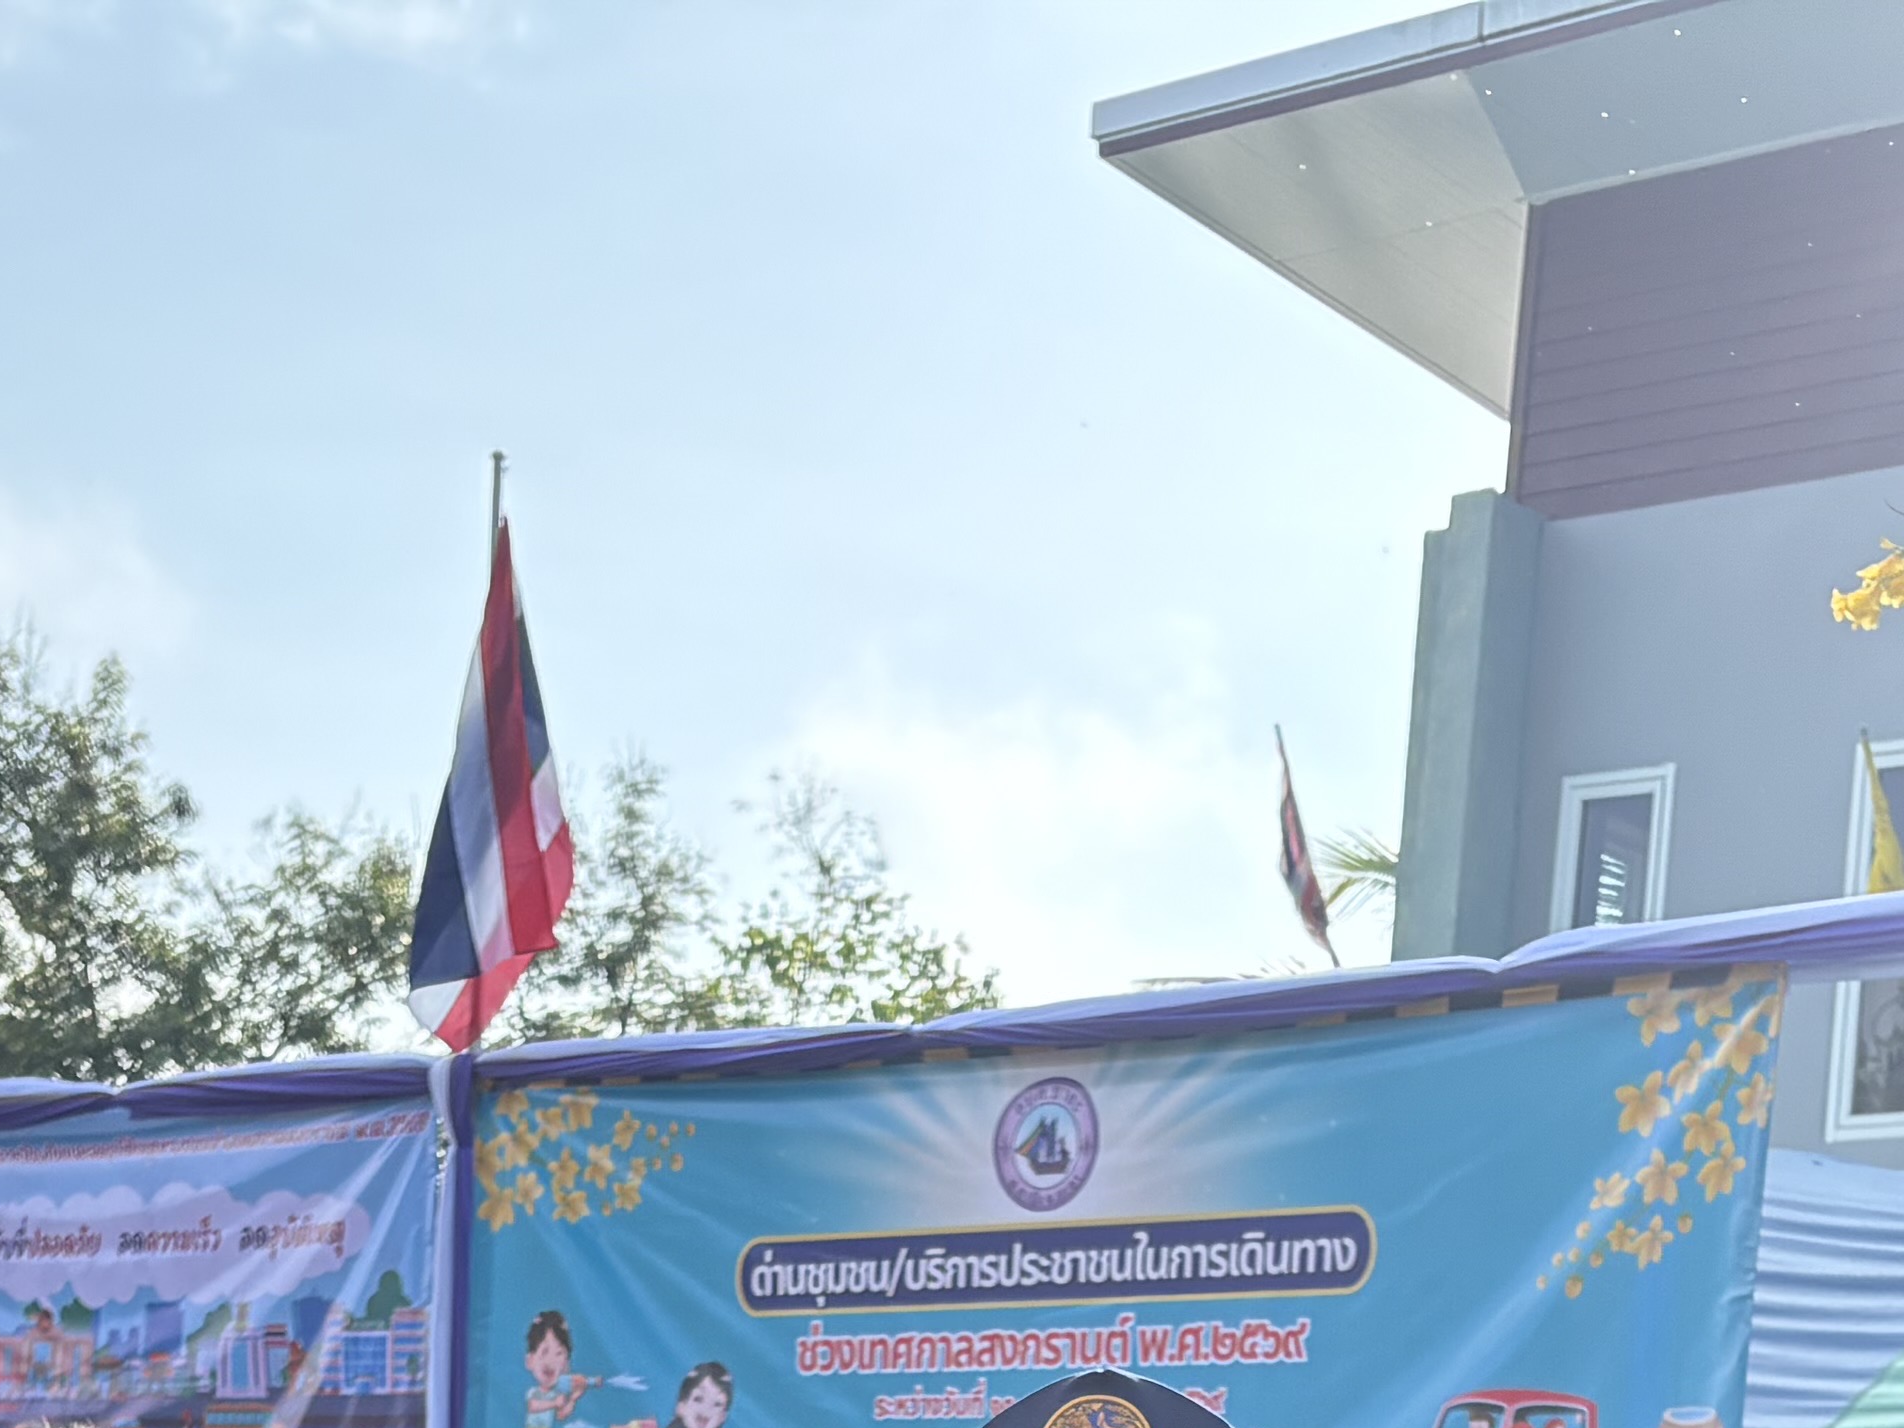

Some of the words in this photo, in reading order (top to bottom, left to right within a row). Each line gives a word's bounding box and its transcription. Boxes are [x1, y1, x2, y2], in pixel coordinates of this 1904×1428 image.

[749, 1231, 1358, 1307] ด่านชุมชน/บริการประชาชนในการเดินทาง
[796, 1313, 1134, 1375] ช่วงเทศกาลสงกรานต์
